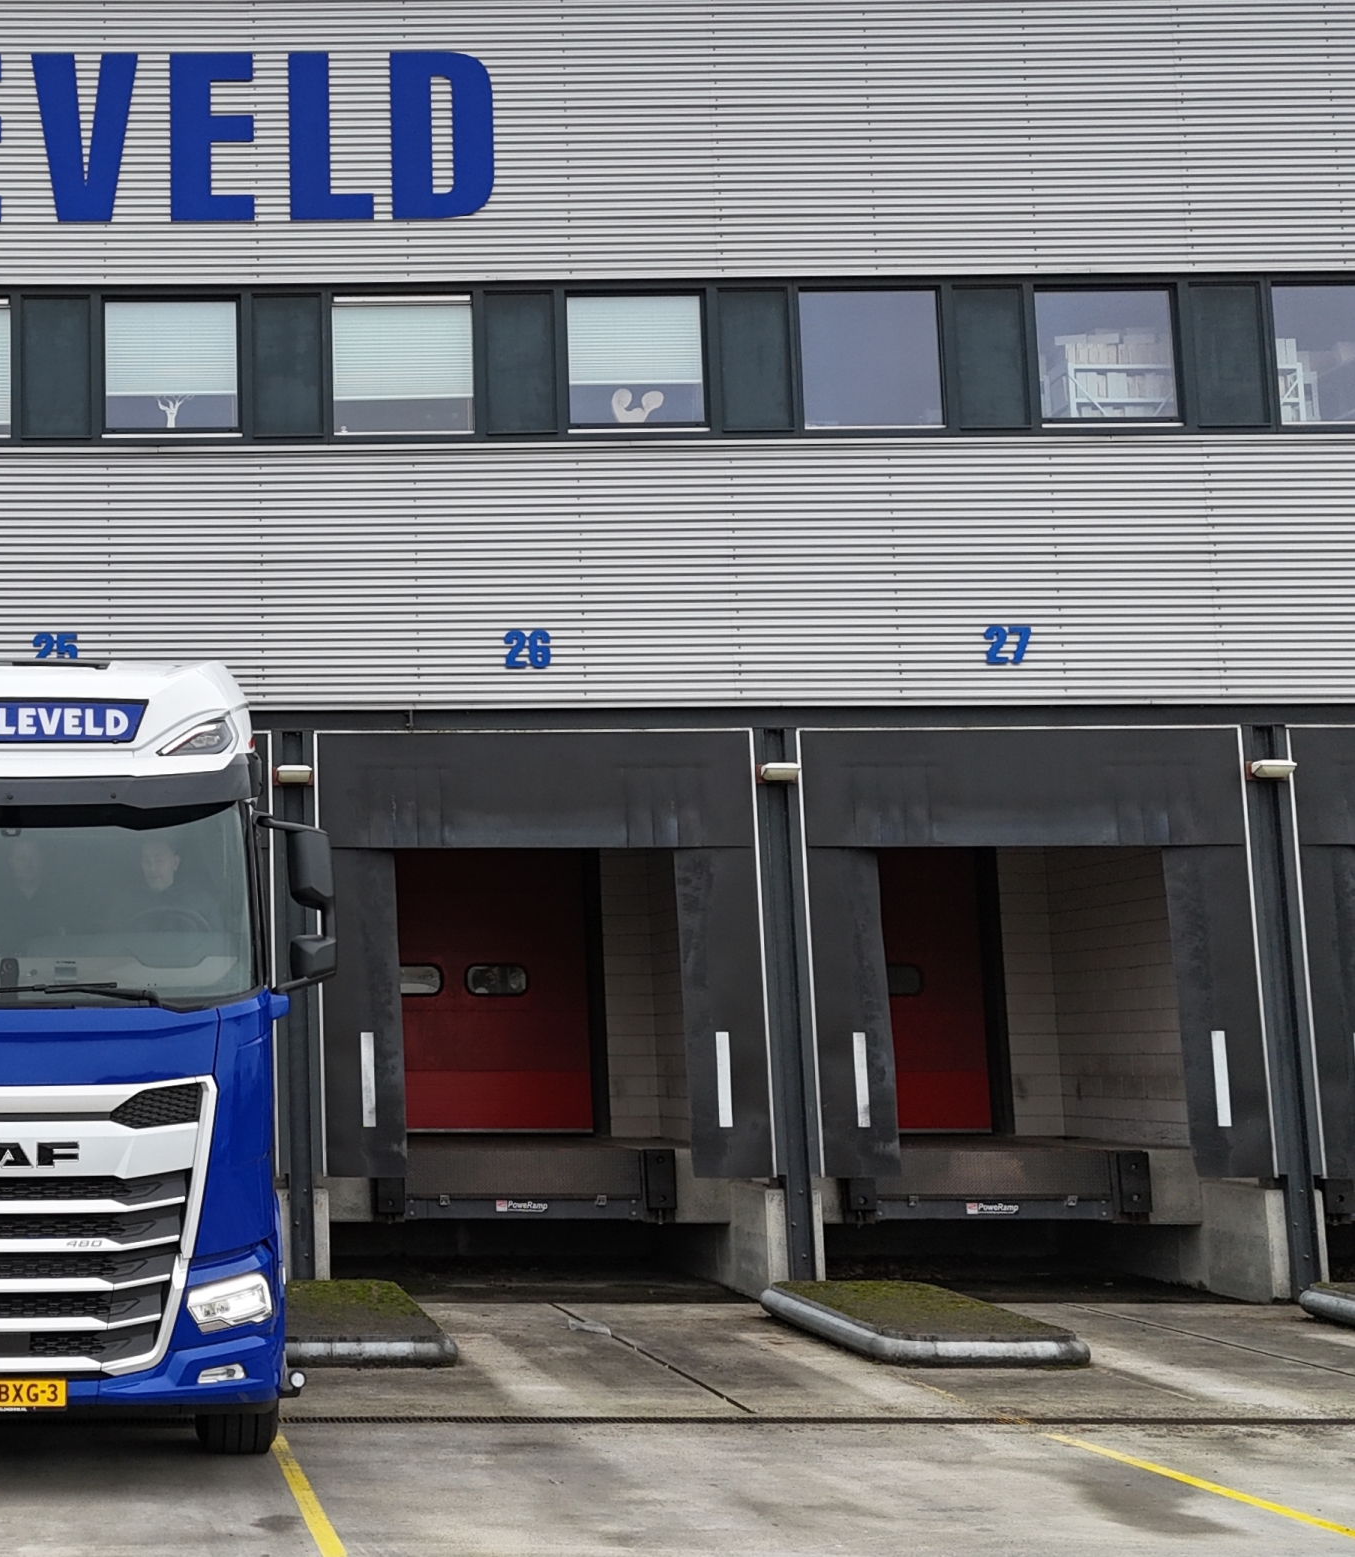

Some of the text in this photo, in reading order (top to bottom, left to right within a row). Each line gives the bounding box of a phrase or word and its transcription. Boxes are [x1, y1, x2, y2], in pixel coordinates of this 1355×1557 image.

[32, 632, 78, 659] 25
[504, 629, 552, 669] 26
[984, 625, 1032, 665] 27
[65, 1239, 104, 1248] 480
